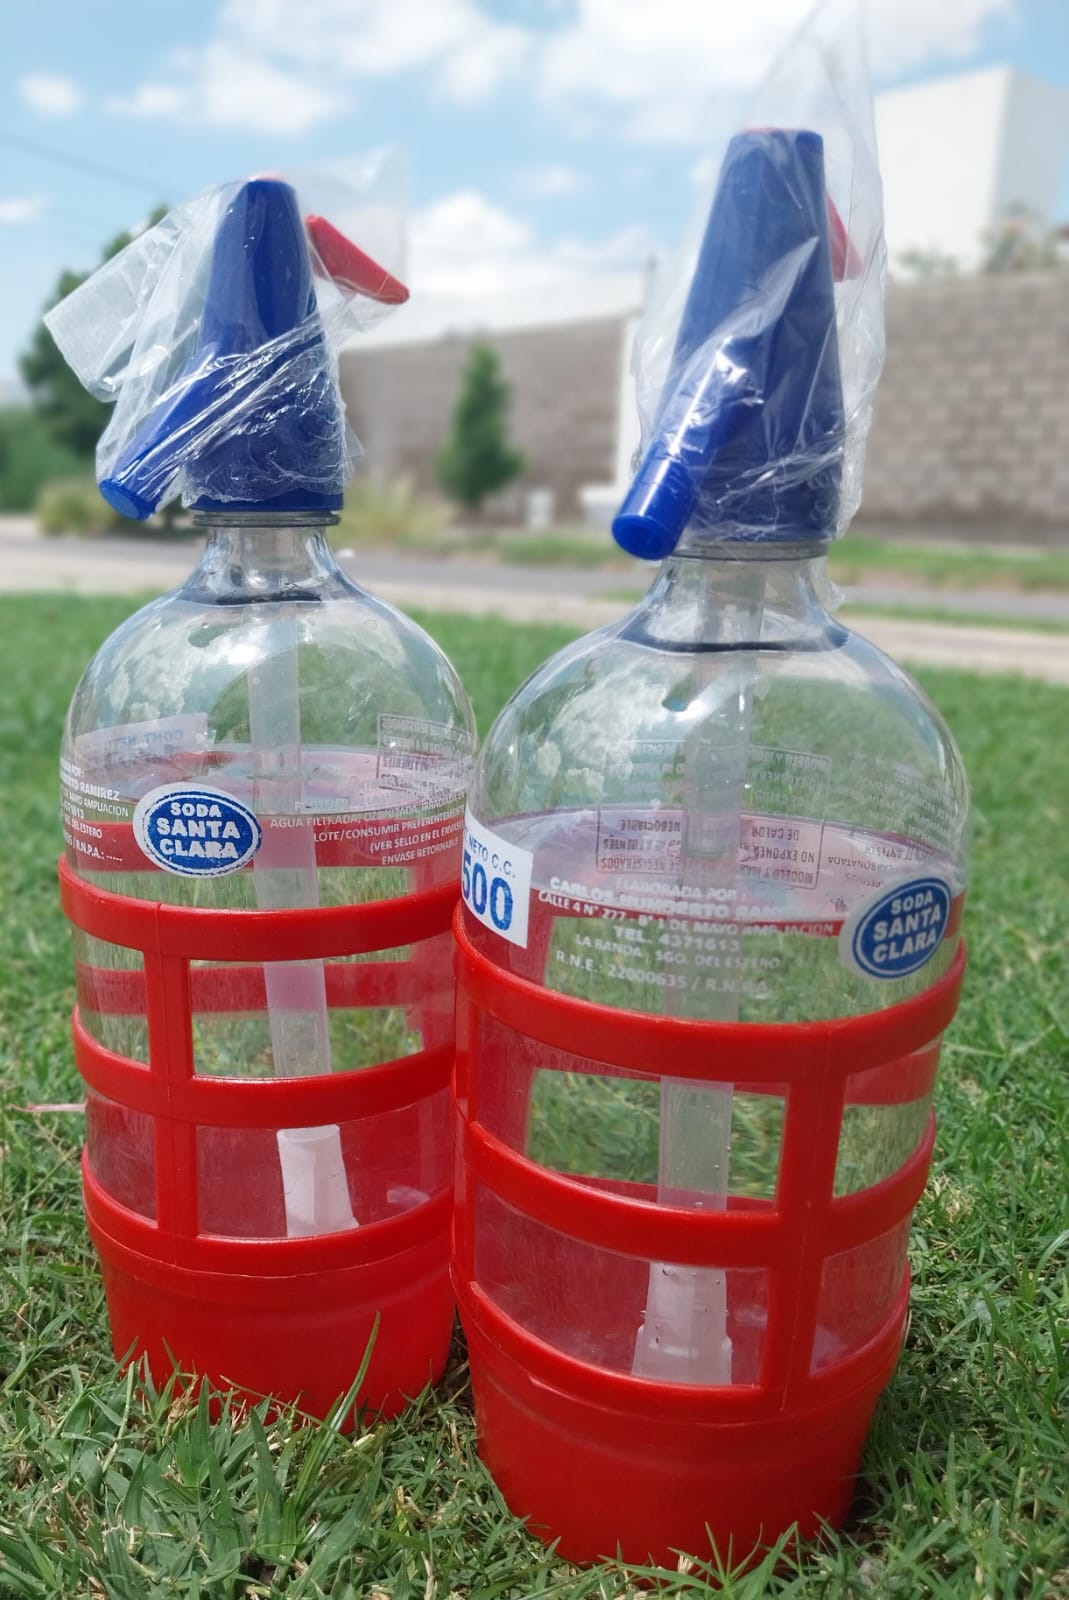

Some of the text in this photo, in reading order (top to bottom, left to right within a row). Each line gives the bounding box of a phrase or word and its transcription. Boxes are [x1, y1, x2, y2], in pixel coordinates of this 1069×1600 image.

[80, 781, 121, 801] RAMIREZ
[84, 797, 129, 817] AMPLIACION
[170, 802, 222, 818] SODA
[80, 820, 103, 839] ESTERO
[157, 817, 241, 839] SANTA
[270, 818, 304, 829] AGUA
[313, 822, 400, 843] LOTE/CONSUMIR
[159, 838, 239, 859] CLARA
[370, 840, 393, 854] (VER
[394, 833, 419, 848] SELLO
[420, 831, 431, 842] EN
[432, 828, 440, 839] EL
[382, 835, 459, 866] ENVASE RETORNABLE
[469, 834, 489, 862] NETO
[491, 853, 516, 879] C.C.
[549, 876, 613, 902] CARLOS
[616, 878, 703, 898] ELABORADA
[538, 890, 570, 909] CALLE
[572, 901, 581, 913] 4
[602, 907, 626, 921] 277
[669, 918, 689, 932] DE
[890, 889, 935, 915] SODA
[613, 924, 652, 944] TEL.
[873, 903, 941, 942] SANTA
[575, 934, 592, 948] LA
[594, 937, 642, 958] BANDA
[695, 954, 721, 968] DEL
[725, 957, 781, 970] ESTERO
[872, 927, 938, 963] CLARA
[607, 963, 688, 989] 22000635
